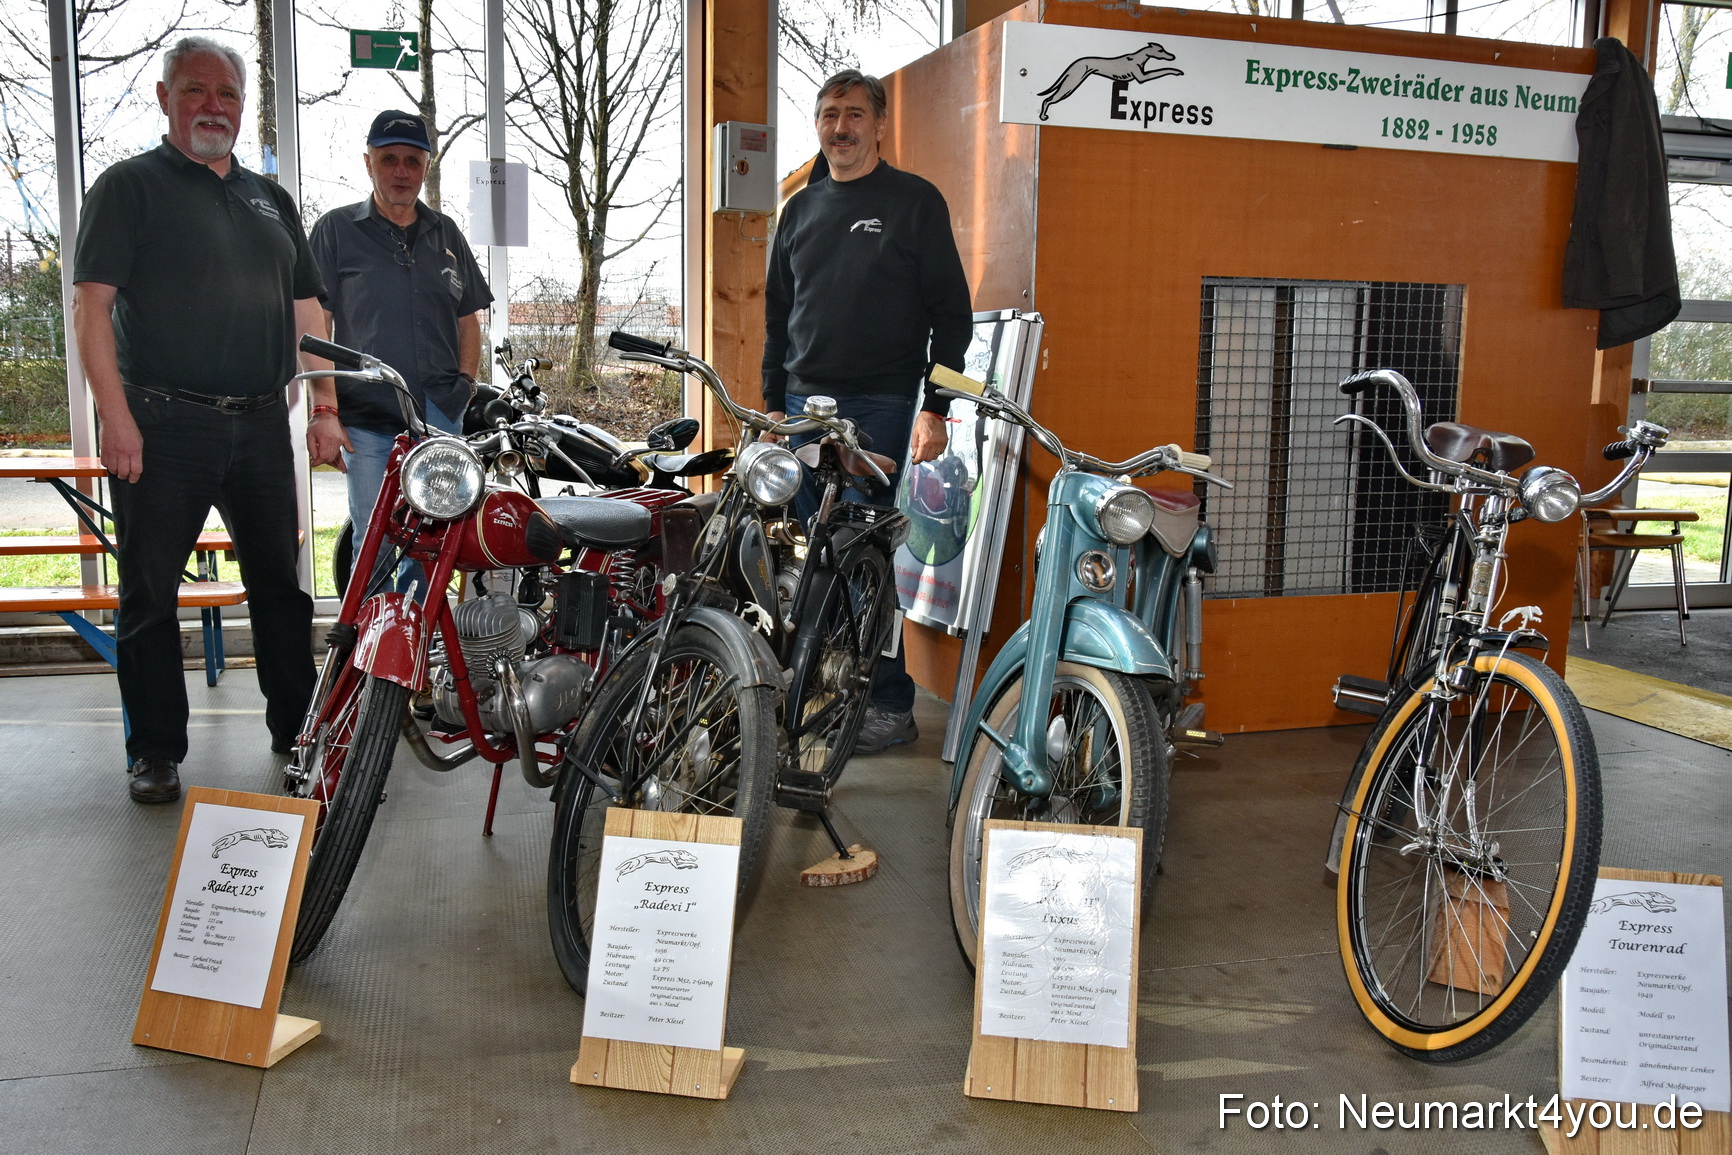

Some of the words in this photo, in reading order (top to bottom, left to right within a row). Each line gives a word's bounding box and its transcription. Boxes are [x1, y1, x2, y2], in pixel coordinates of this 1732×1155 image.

[1245, 59, 1465, 104] Express-Zweiräder
[1469, 83, 1509, 107] aus
[1110, 81, 1214, 128] Express
[1381, 116, 1430, 141] 1882
[1451, 122, 1498, 146] 1958
[475, 176, 506, 187] Express
[220, 863, 258, 879] Express
[644, 881, 690, 895] Express
[1041, 912, 1080, 925] Luxus
[609, 925, 640, 933] Hersteller:
[656, 929, 698, 938] Expresswerke
[1618, 919, 1673, 935] Express
[606, 943, 633, 951] Baujahr:
[655, 938, 702, 949] Neumarkt/Opf.
[1053, 937, 1097, 946] Expresswerke
[1608, 938, 1688, 955] Tourenrad
[605, 952, 637, 961] Hubraum:
[1002, 951, 1029, 960] Baujahr:
[604, 961, 632, 970] Leistung:
[1001, 960, 1034, 969] Hubraum:
[652, 974, 675, 983] Express
[1579, 966, 1617, 976] Hersteller:
[1637, 971, 1686, 981] Expresswerke
[602, 979, 629, 987] Zustand:
[650, 985, 690, 993] unrestaurierter
[1051, 983, 1076, 992] Express
[1579, 986, 1611, 995] Baujahr:
[1637, 981, 1693, 993] Neumarkt/Opf.
[1000, 988, 1028, 996] Zustand:
[663, 1000, 680, 1008] Hand
[599, 1011, 626, 1019] Besitzer:
[998, 1012, 1026, 1021] Besitzer:
[1579, 1006, 1606, 1014] Modell:
[1638, 1011, 1663, 1019] Modell
[1579, 1026, 1611, 1035] Zustand:
[1639, 1031, 1695, 1042] unrestaurierter
[1638, 1041, 1699, 1052] Originalzustand
[1580, 1056, 1629, 1067] Besonderheit:
[1639, 1061, 1688, 1072] abnehmbarer
[1690, 1065, 1716, 1074] Lenker
[1580, 1074, 1612, 1083] Besitzer:
[1639, 1079, 1664, 1089] Alfred
